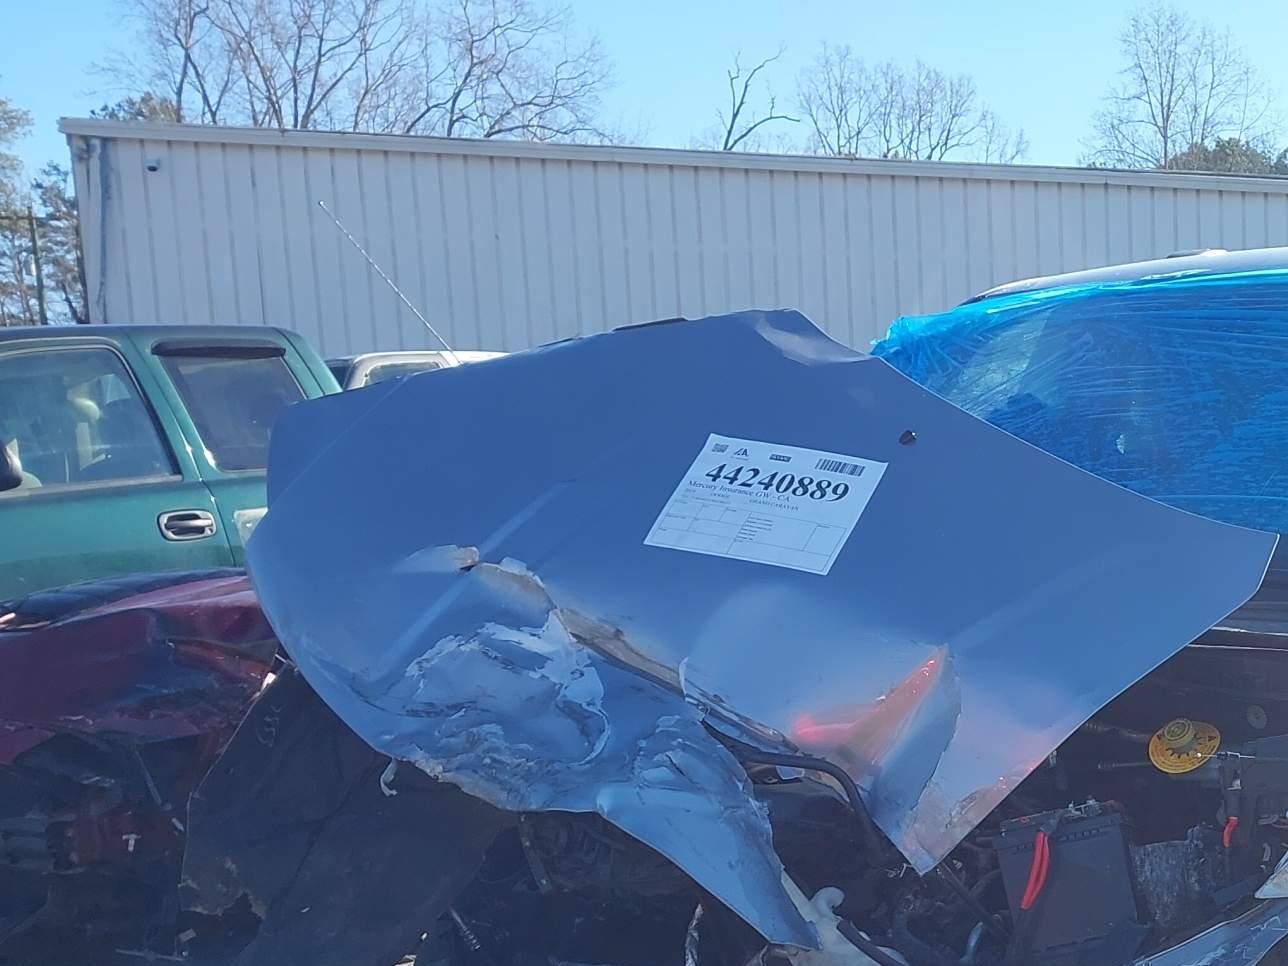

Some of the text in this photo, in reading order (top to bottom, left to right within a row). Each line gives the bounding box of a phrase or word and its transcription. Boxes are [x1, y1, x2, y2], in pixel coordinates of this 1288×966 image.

[688, 479, 718, 491] Mercury
[719, 485, 754, 497] Insurance
[705, 463, 850, 503] 44240889
